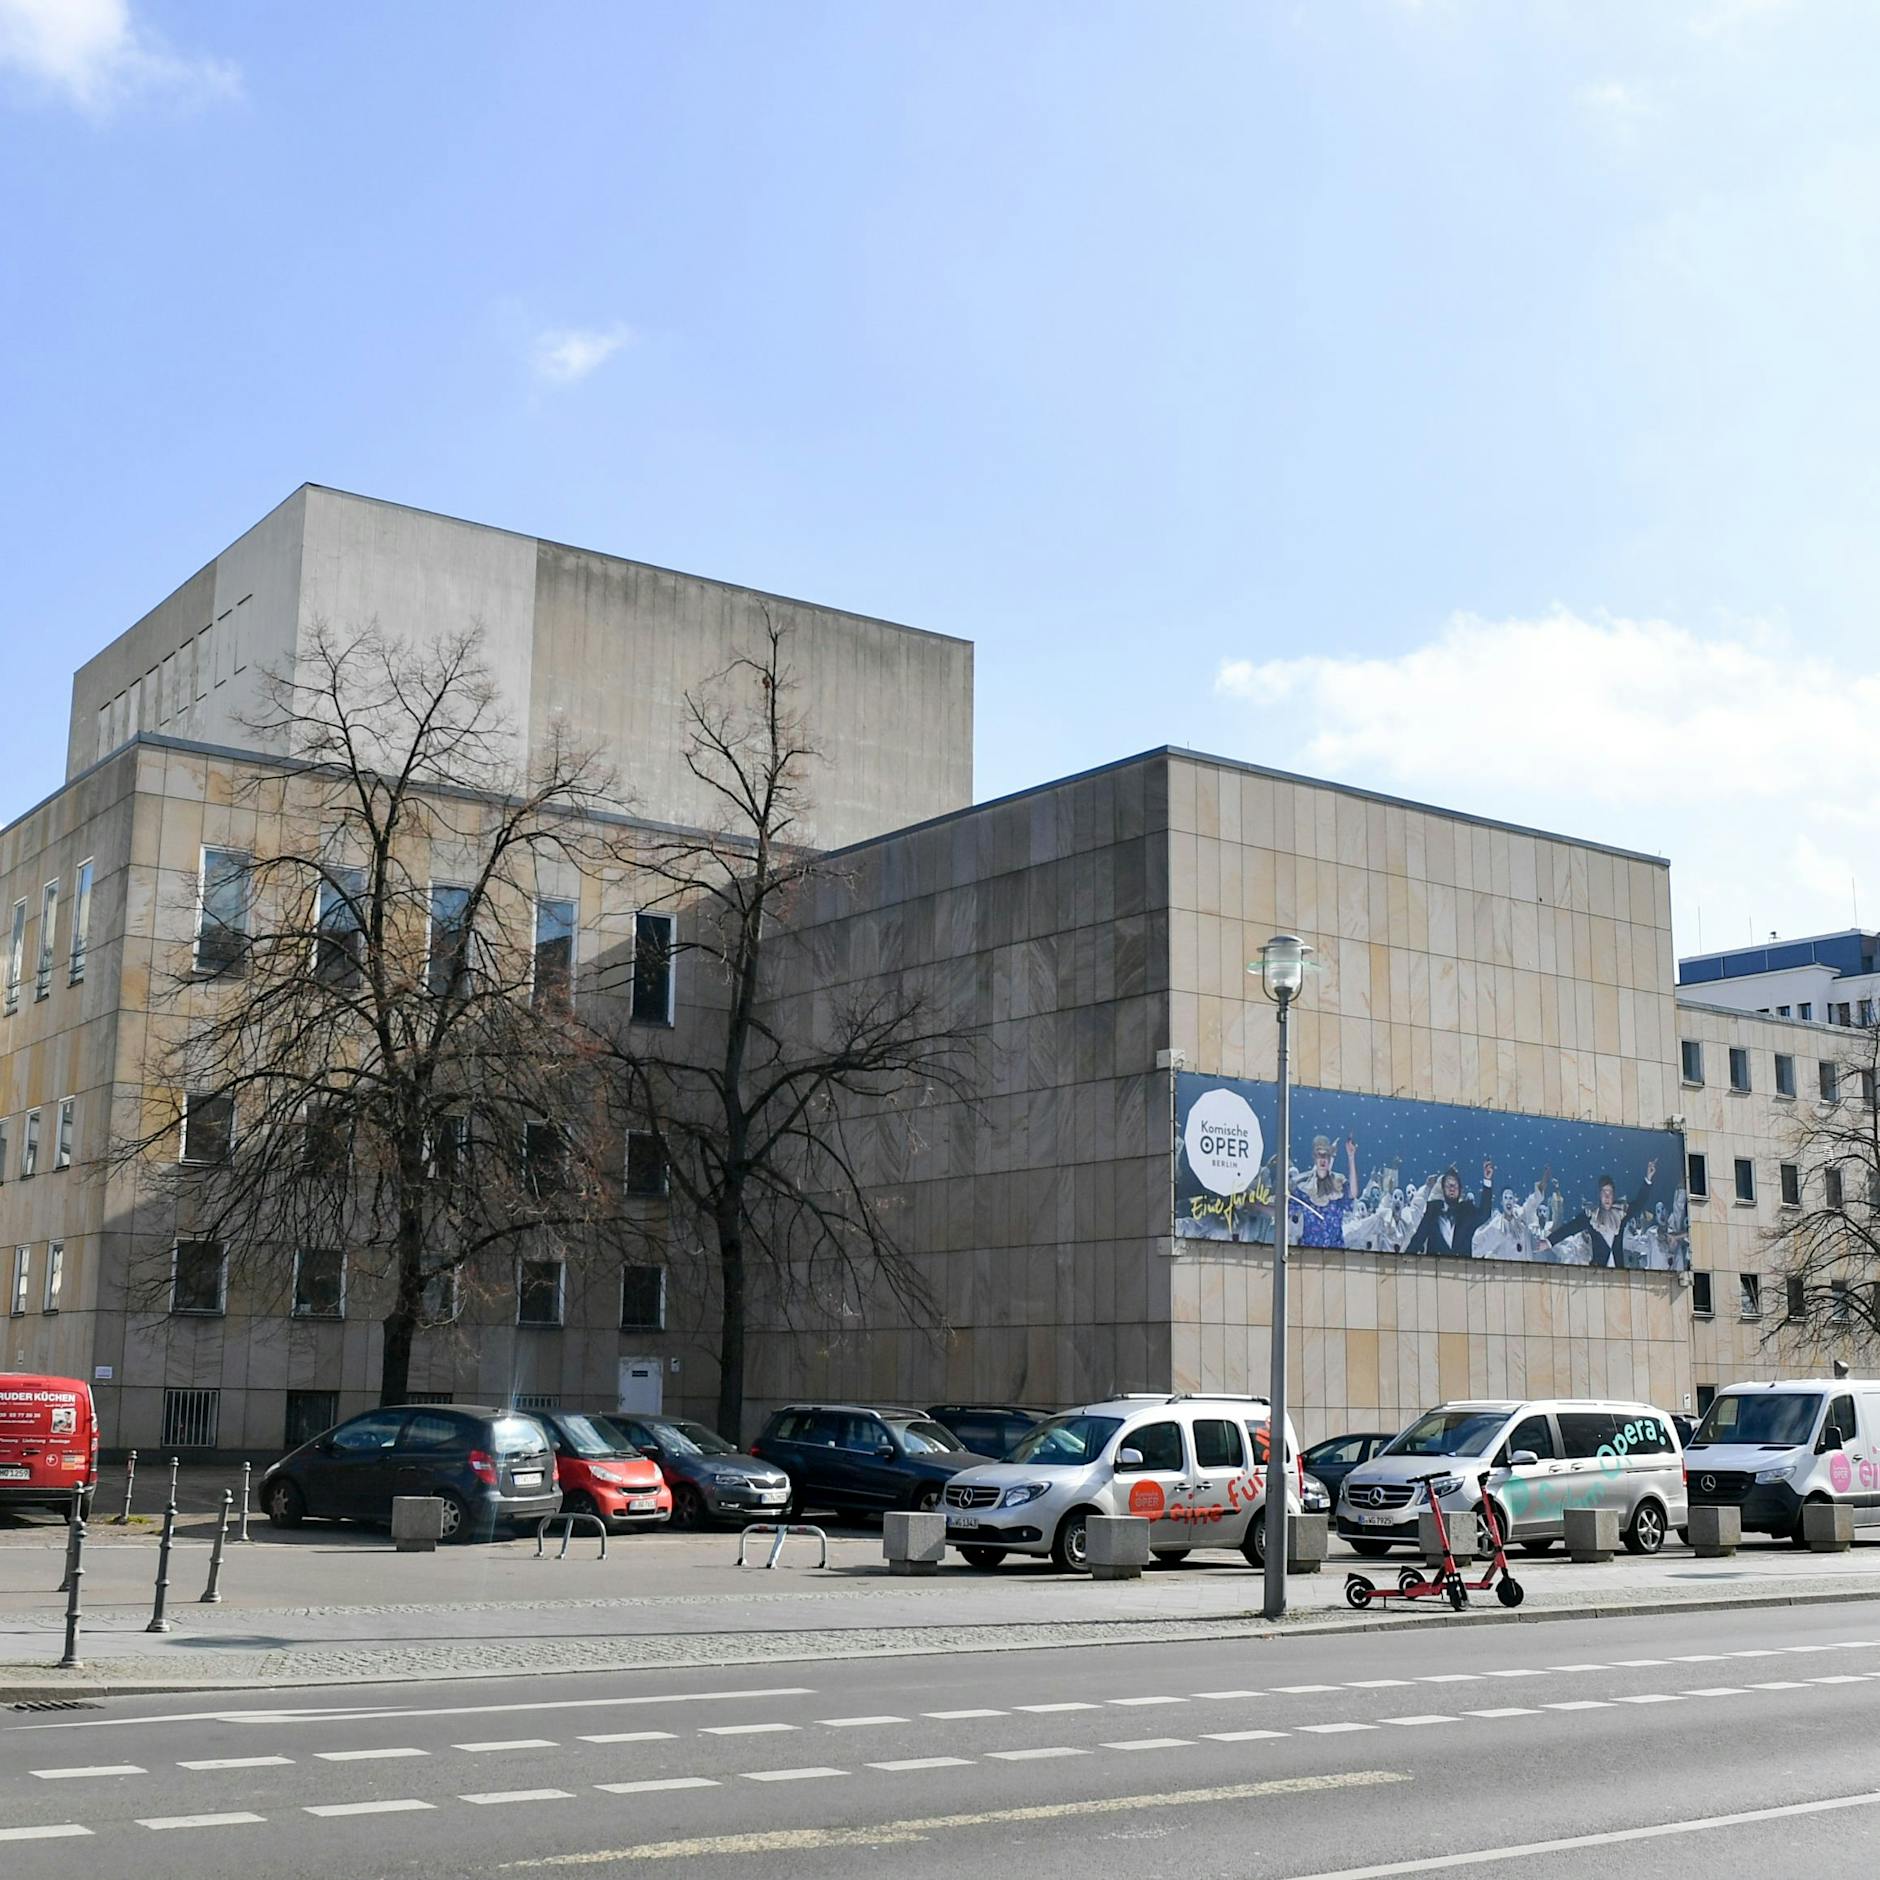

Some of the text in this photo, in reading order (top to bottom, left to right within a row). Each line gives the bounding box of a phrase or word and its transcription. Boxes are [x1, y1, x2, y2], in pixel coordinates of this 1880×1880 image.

[1201, 1120, 1248, 1138] Komische
[1200, 1136, 1249, 1158] OPER
[1212, 1160, 1238, 1169] BERLIN
[1190, 1195, 1224, 1221] Eine
[1249, 1175, 1271, 1205] alle
[34, 1391, 76, 1402] KÜCHEN
[1597, 1418, 1666, 1480] Opera!
[1859, 1446, 1880, 1489] ei
[1170, 1493, 1224, 1525] eine
[1228, 1467, 1265, 1511] für
